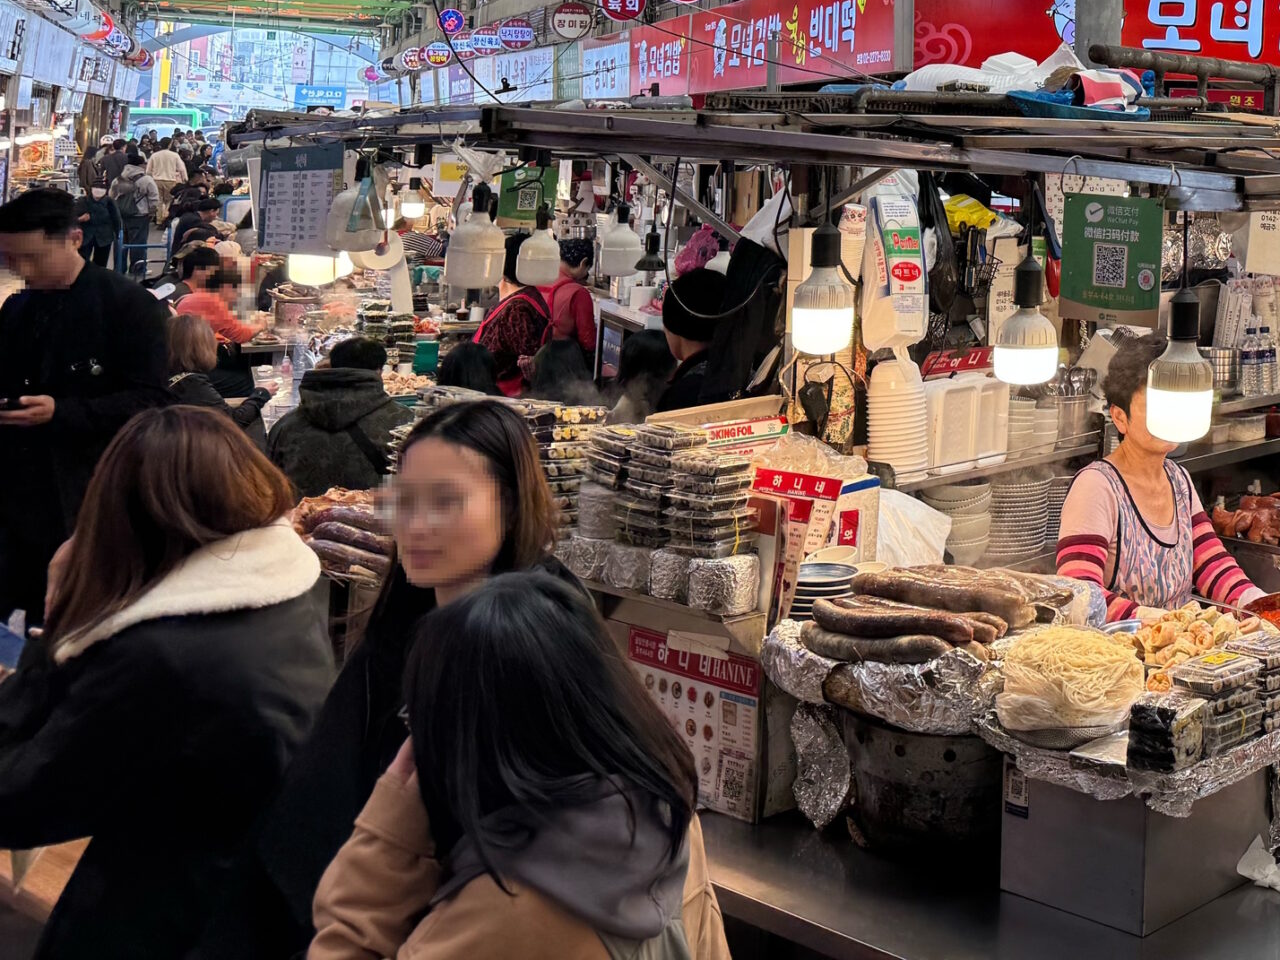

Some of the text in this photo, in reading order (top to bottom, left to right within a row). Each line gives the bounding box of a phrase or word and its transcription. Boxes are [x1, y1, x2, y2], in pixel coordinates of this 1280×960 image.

[557, 19, 588, 29] 장미집
[728, 13, 782, 69] 모녀김밥
[648, 39, 682, 80] 모녀김밥
[1229, 94, 1256, 107] 원조
[1107, 206, 1139, 217] 微信支付
[1084, 226, 1140, 242] 微信扫码付款
[710, 425, 755, 440] OKING FOIL
[772, 475, 826, 493] 하니네
[713, 660, 755, 688] HANINE
